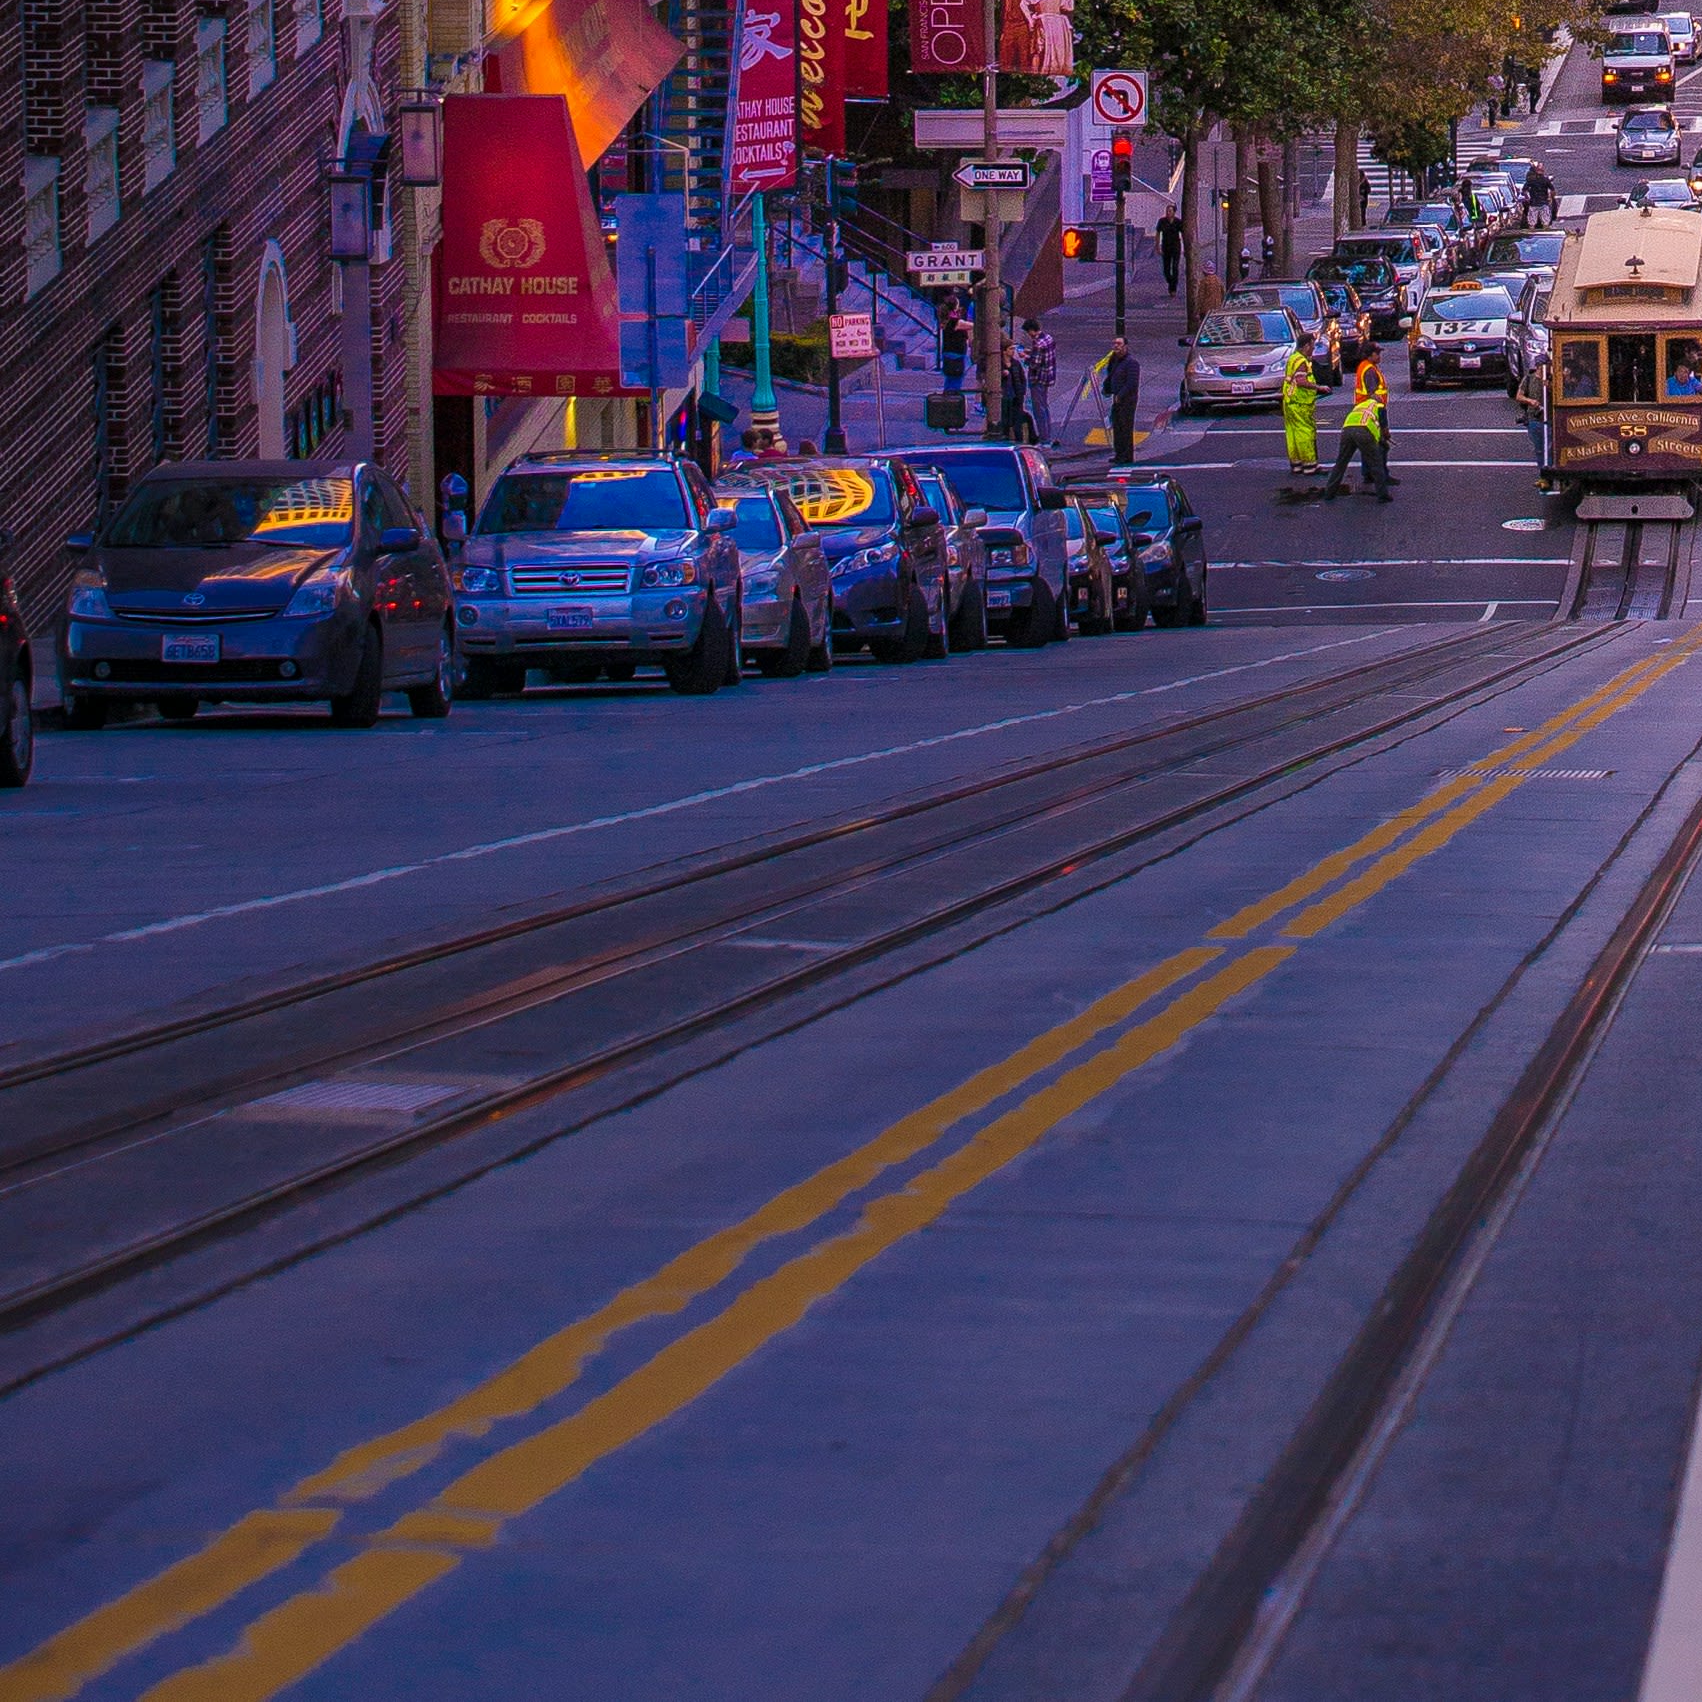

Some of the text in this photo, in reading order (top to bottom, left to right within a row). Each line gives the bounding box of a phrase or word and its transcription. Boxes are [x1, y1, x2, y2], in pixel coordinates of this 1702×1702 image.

[920, 42, 930, 60] SAN
[736, 96, 795, 120] ATHAY HOUSE
[735, 118, 795, 142] ESTAURANT
[974, 169, 1020, 181] ONE WAY
[914, 254, 977, 268] GRANT
[448, 276, 578, 295] CATHAY HOUSE
[447, 313, 578, 324] RESTAURANT COCKTAILS
[831, 317, 869, 328] NO PARKING
[1433, 321, 1493, 335] 1327
[1569, 417, 1589, 428] Van
[1589, 413, 1614, 425] Ness
[1646, 411, 1699, 426] California
[1620, 425, 1648, 437] 58
[1566, 440, 1702, 457] & Market Streets
